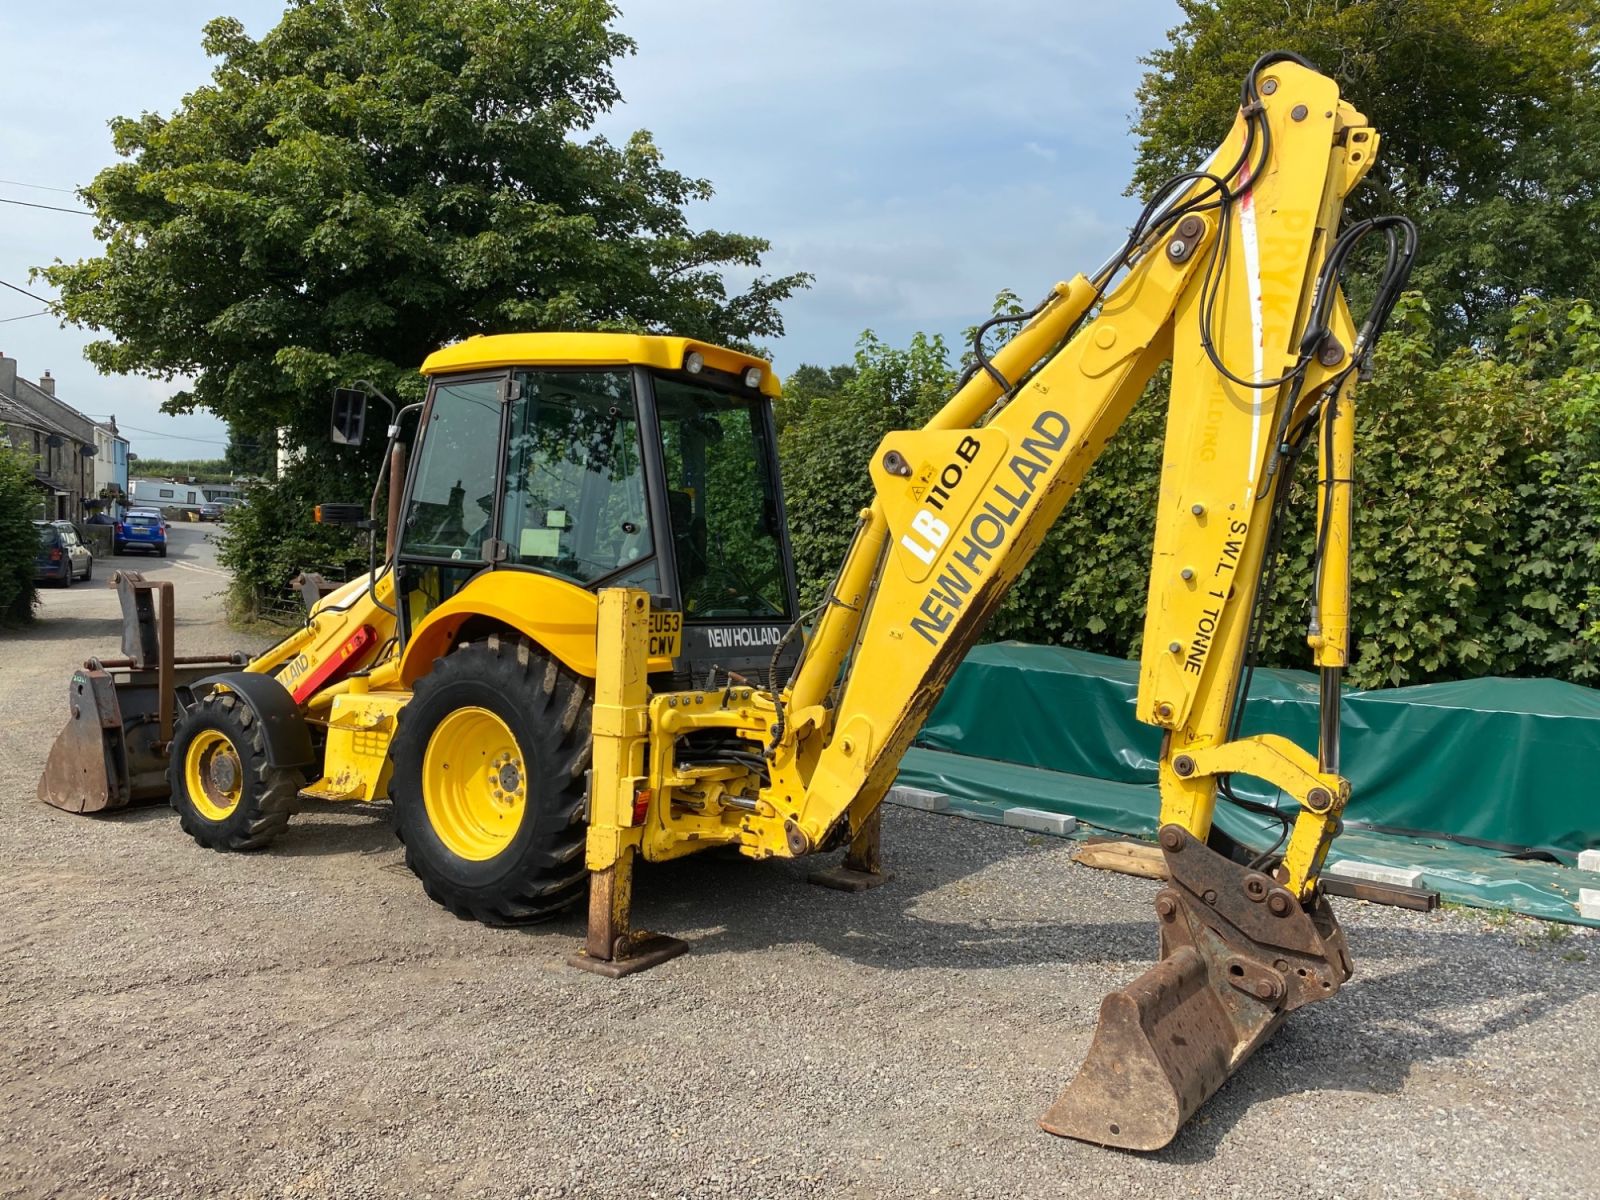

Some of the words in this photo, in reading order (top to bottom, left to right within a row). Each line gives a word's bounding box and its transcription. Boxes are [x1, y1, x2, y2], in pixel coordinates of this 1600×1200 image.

[1200, 382, 1225, 463] ILDING
[900, 509, 951, 566] LB
[910, 562, 973, 646] NEW
[952, 410, 1071, 576] HOLLAND
[1208, 590, 1225, 600] 1
[648, 614, 680, 633] EU53
[708, 628, 733, 648] NEW
[733, 627, 781, 647] HOLLAND
[650, 636, 675, 655] CWV
[1184, 608, 1220, 676] TONNE
[279, 654, 309, 686] LLAND
